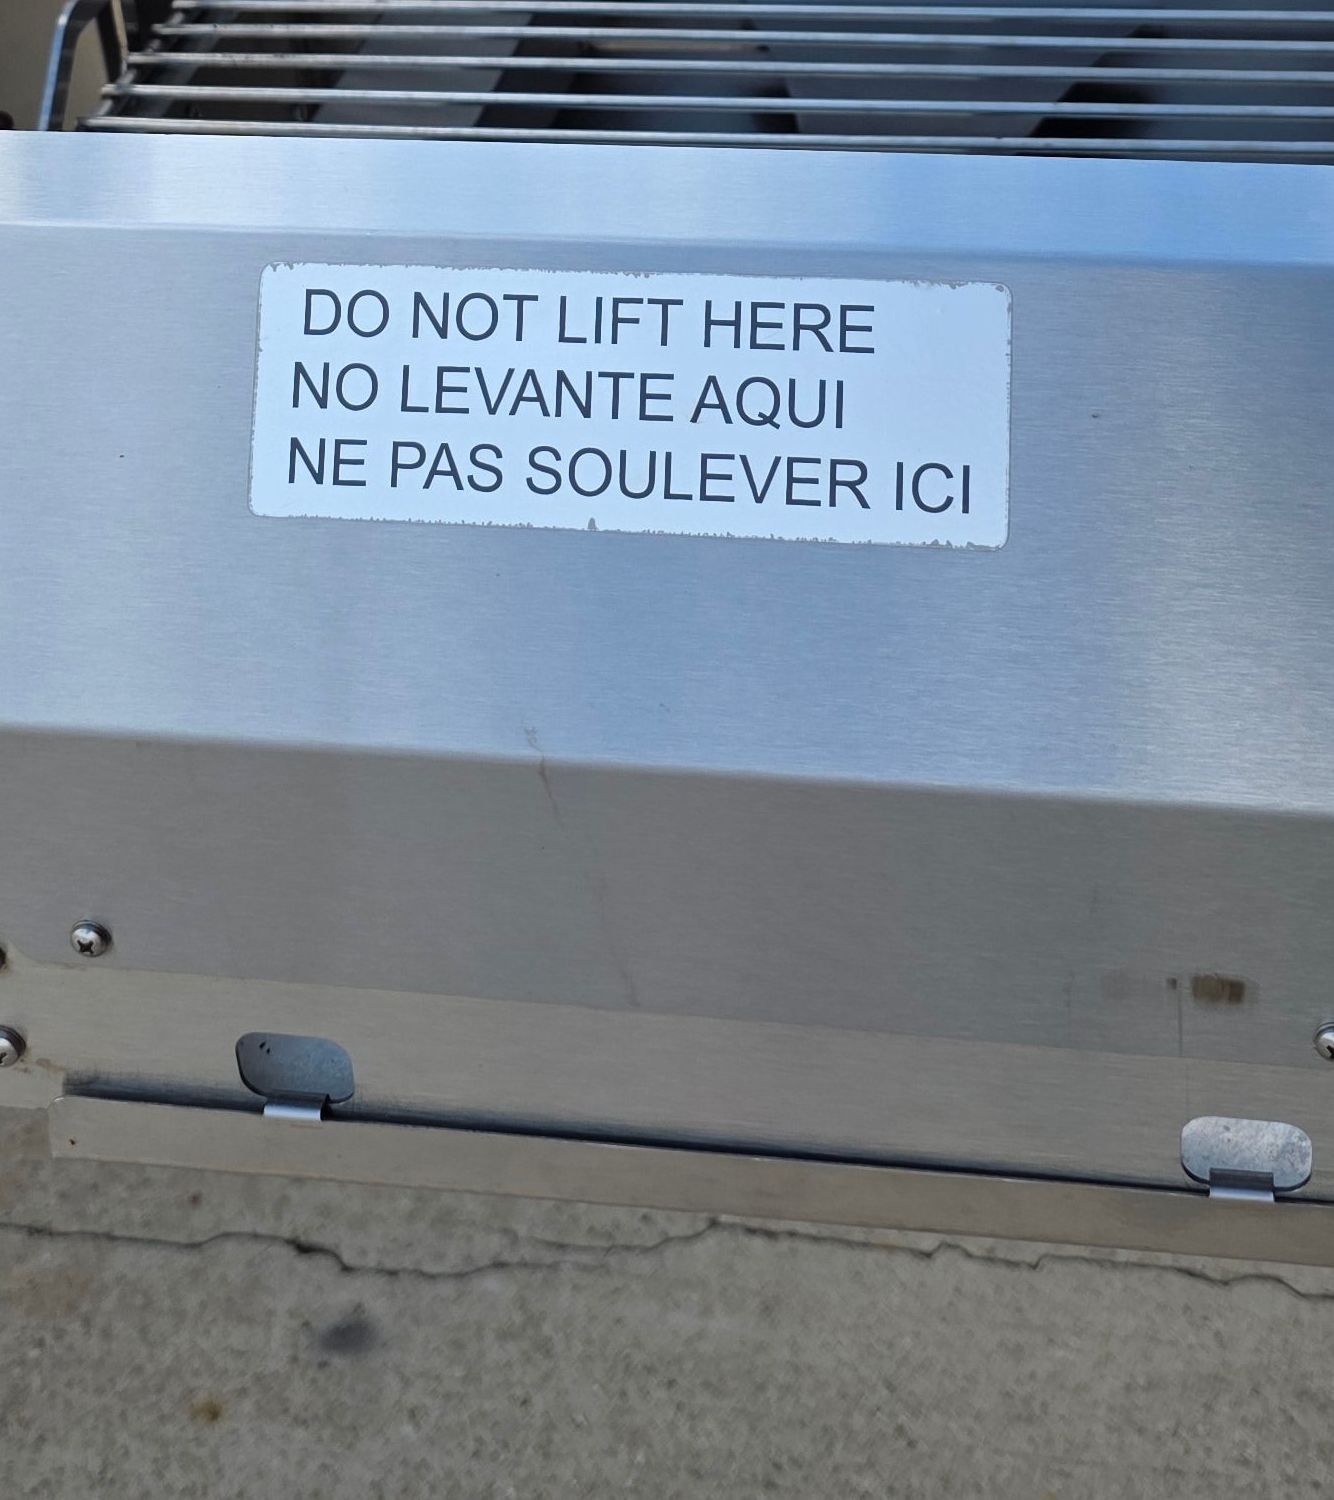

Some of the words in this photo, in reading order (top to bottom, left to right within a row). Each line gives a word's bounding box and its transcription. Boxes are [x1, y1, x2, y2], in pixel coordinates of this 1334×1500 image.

[304, 289, 389, 337] DO
[413, 292, 538, 341] NOT
[559, 296, 683, 346] LIFT
[704, 300, 874, 353] HERE
[293, 362, 378, 411] NO
[401, 365, 674, 421] LEVANTE
[690, 376, 843, 429] AQUI
[289, 438, 367, 486] NE
[391, 441, 502, 492] PAS
[526, 446, 870, 509] SOULEVER
[896, 462, 969, 513] ICI
